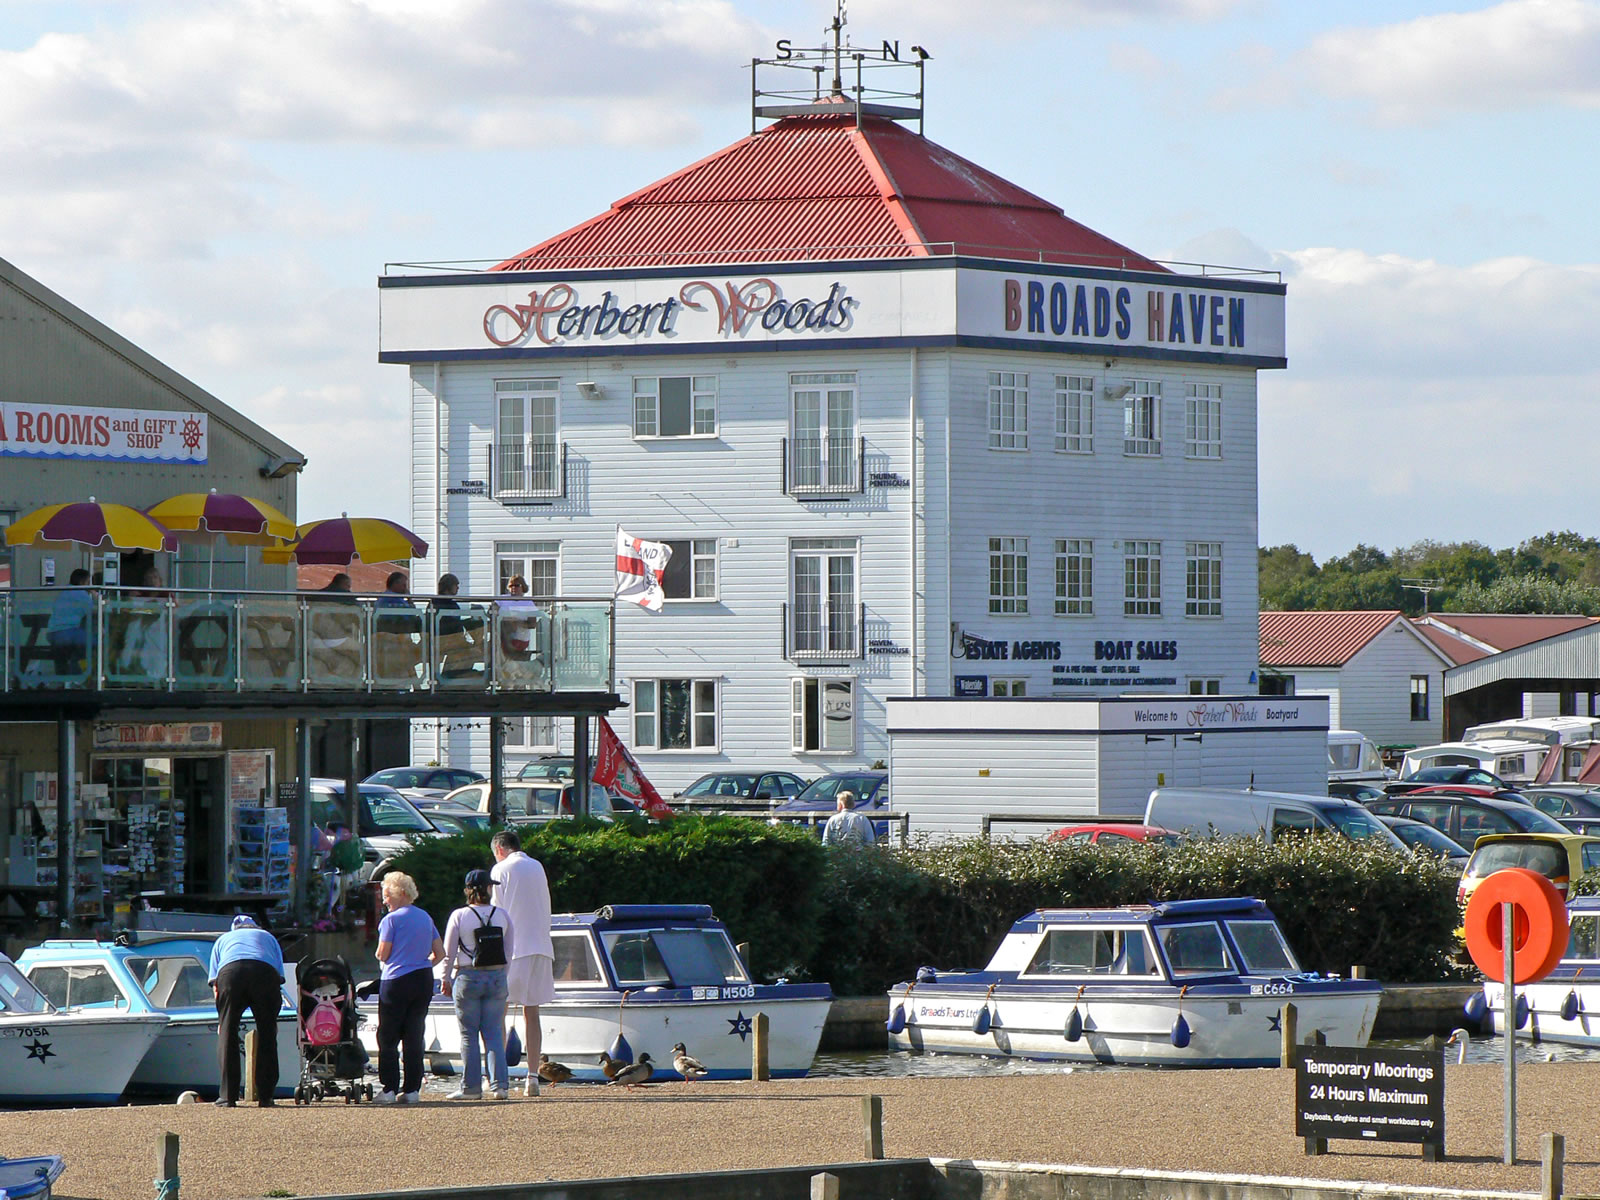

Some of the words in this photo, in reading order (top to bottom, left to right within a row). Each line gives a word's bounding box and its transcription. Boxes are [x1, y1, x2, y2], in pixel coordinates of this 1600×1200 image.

[776, 39, 792, 60] S
[882, 40, 899, 61] N
[483, 283, 678, 347] Herbert
[679, 277, 853, 335] Woods
[1005, 279, 1131, 340] BROADS
[1147, 290, 1245, 348] HAVEN
[15, 410, 111, 448] ROOMS
[112, 418, 139, 433] and
[143, 418, 177, 435] GIFT
[126, 432, 163, 449] SHOP
[446, 487, 485, 495] PENTHOUSE
[869, 479, 910, 488] PENTHOUSE
[868, 639, 894, 647] HAVEN
[868, 647, 910, 655] PENTHOUSE
[965, 640, 1008, 660] ESTATE
[1011, 641, 1062, 660] AGENTS
[1094, 640, 1133, 661] BOAT
[1136, 640, 1178, 661] SALES
[1134, 710, 1169, 722] Welcome
[1170, 710, 1178, 722] to
[1186, 703, 1226, 727] Herbert
[1225, 702, 1258, 722] Woods
[1266, 708, 1299, 722] Boatyard
[722, 986, 755, 999] M508
[1263, 983, 1294, 995] C664
[920, 1006, 946, 1017] Broads
[946, 1007, 965, 1018] Tours
[17, 1027, 49, 1038] 705A
[738, 1021, 746, 1031] 6
[1304, 1058, 1371, 1080] Temporary
[1374, 1062, 1434, 1083] Moorings
[1309, 1085, 1326, 1099] 24
[1328, 1085, 1365, 1102] Hours
[1368, 1088, 1429, 1105] Maximum
[1303, 1112, 1333, 1122] Dayboats,
[1333, 1113, 1358, 1123] dinghies
[1359, 1115, 1371, 1123] and
[1371, 1116, 1388, 1124] small
[1388, 1118, 1420, 1127] workboats
[1420, 1119, 1434, 1129] only
